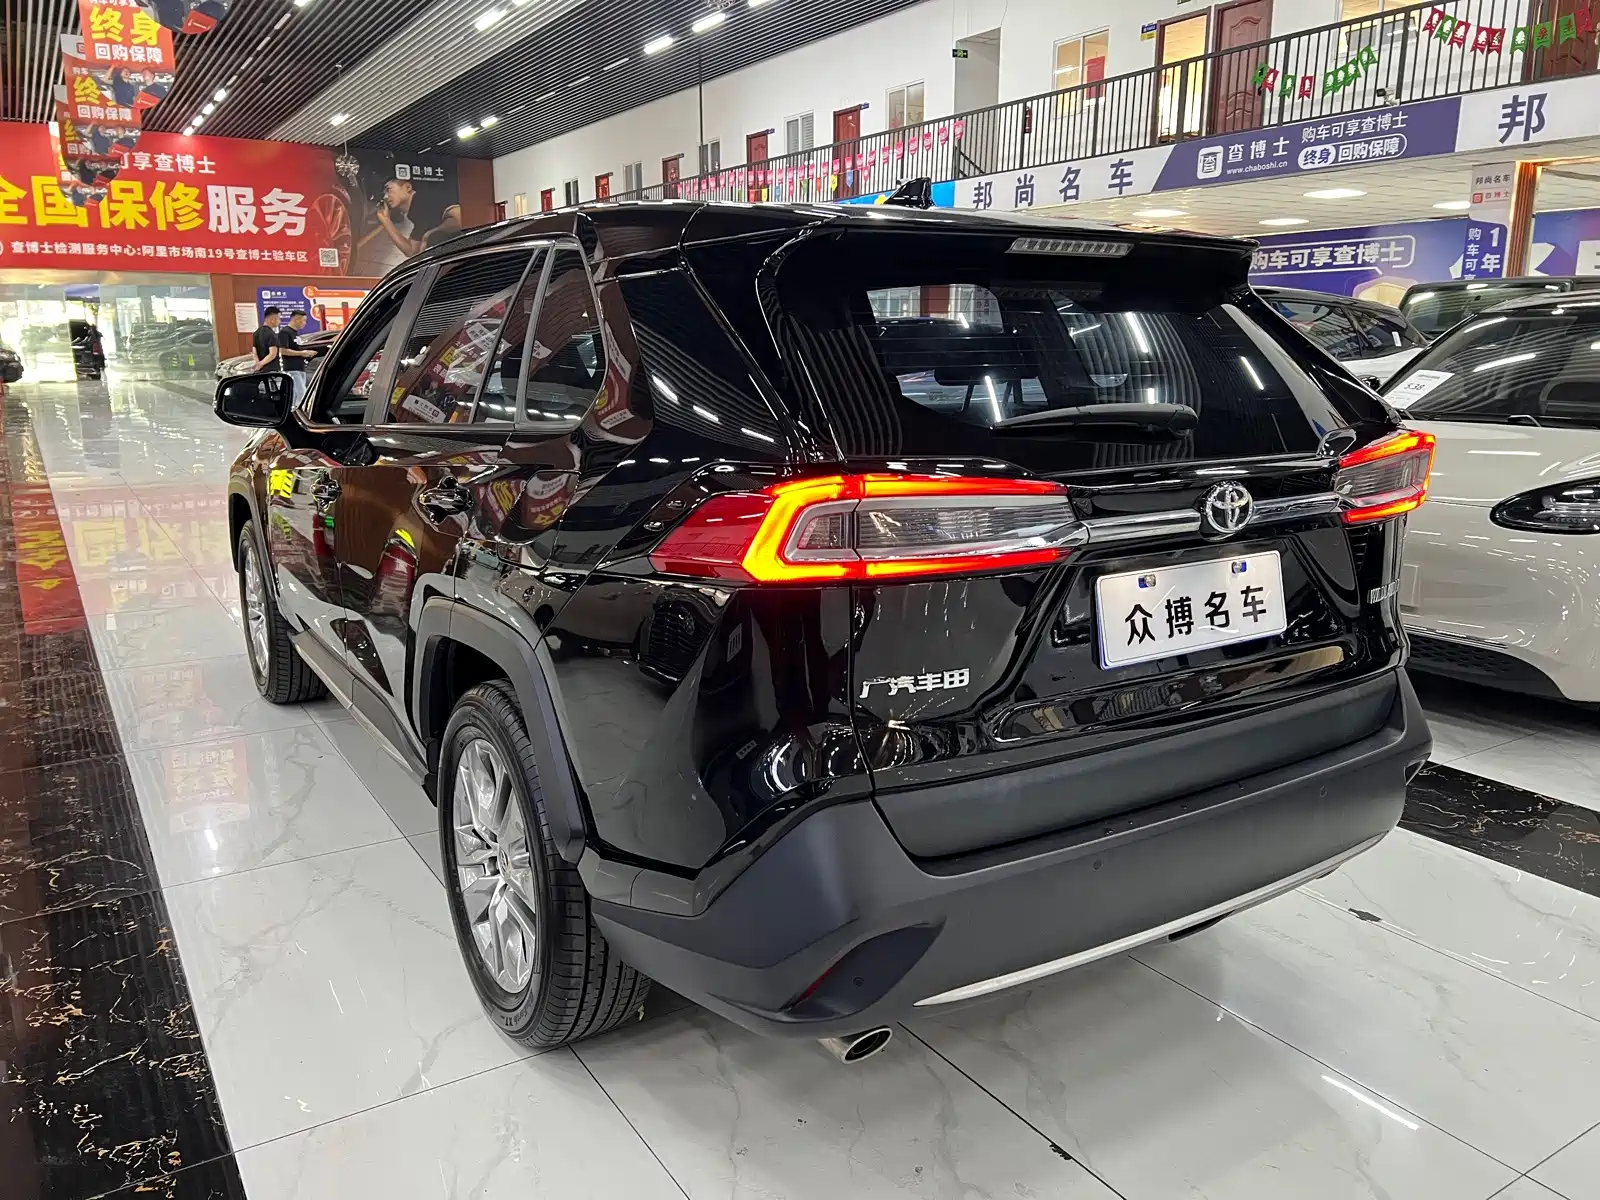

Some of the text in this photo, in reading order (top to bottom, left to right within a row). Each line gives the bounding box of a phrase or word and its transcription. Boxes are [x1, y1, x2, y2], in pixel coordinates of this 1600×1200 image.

[89, 8, 160, 46] 终身
[94, 43, 164, 65] 回购保障
[77, 104, 132, 121] 回购保障
[1301, 111, 1409, 143] 购车可享查博士
[1498, 93, 1548, 144] 邦
[1227, 136, 1290, 163] 查博士
[1303, 137, 1400, 166] 终身 回购保障
[972, 158, 1134, 209] 邦尚名车
[1475, 174, 1511, 185] 邦尚名车
[1251, 242, 1405, 271] 购车可享查博士
[859, 668, 970, 698] 广汽丰田
